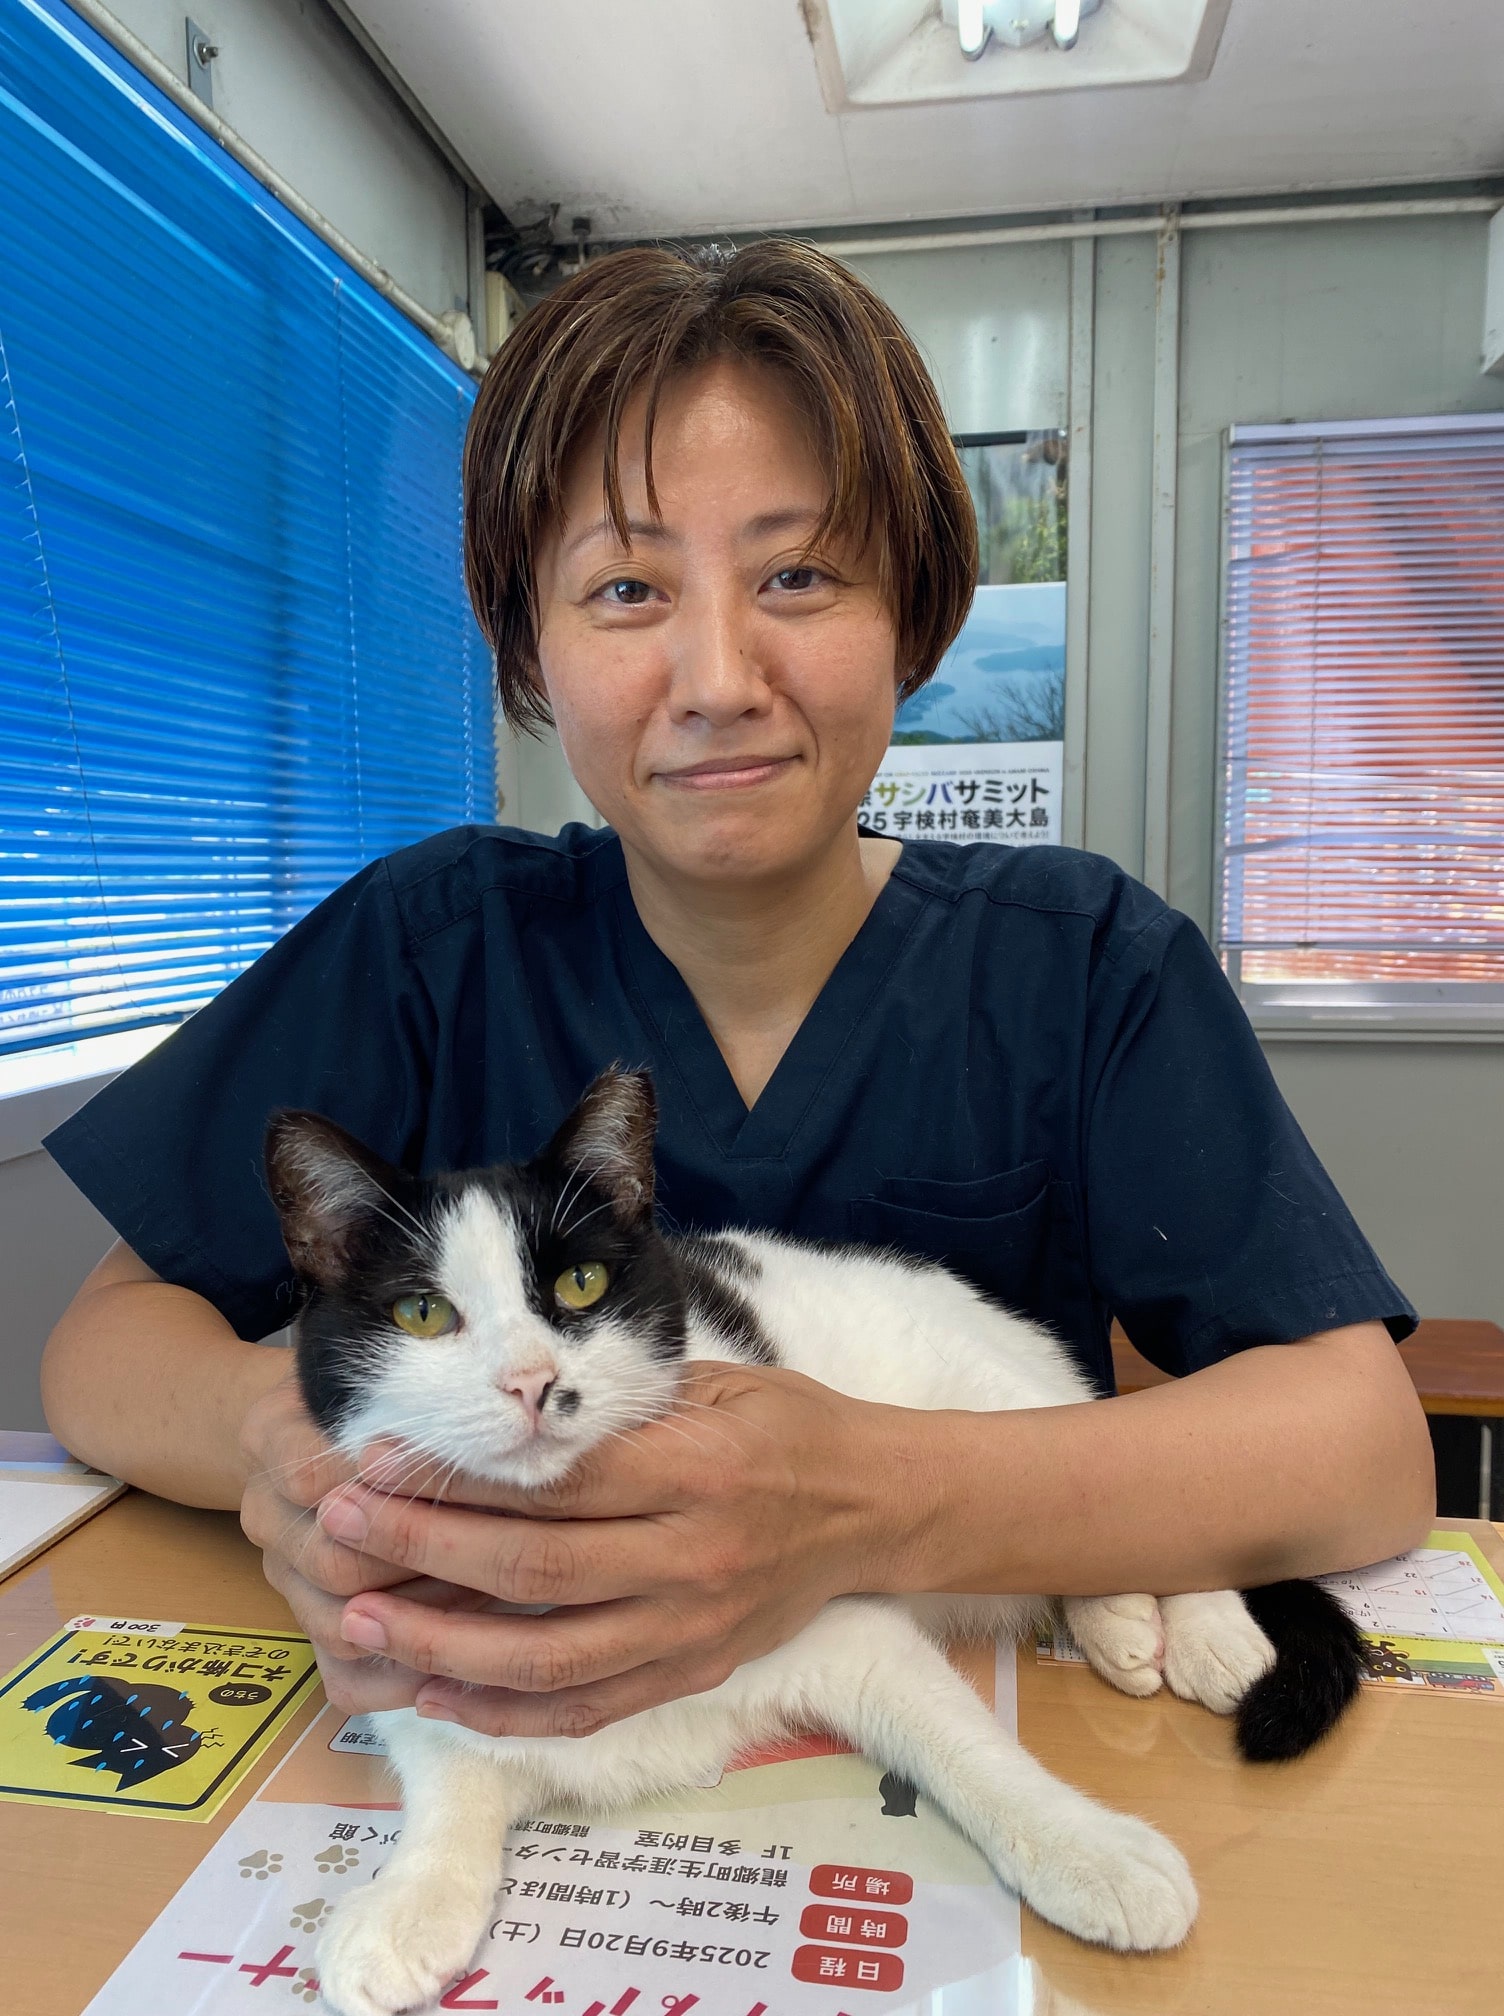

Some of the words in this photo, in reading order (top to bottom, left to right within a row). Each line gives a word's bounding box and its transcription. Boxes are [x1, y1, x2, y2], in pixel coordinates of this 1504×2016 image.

[110, 1621, 161, 1633] 300円
[102, 1634, 290, 1661] のぞき込まないで!
[66, 1648, 292, 1682] ネコ怖がりです!
[220, 1689, 260, 1701] うちの
[340, 1730, 387, 1749] 定期
[506, 1818, 591, 1838] 龍郷町瀬
[633, 1829, 742, 1857] 多目的室
[760, 1844, 794, 1860] 1F
[831, 1872, 891, 1896] 場所
[825, 1914, 887, 1938] 時間
[819, 1955, 881, 1981] 日程
